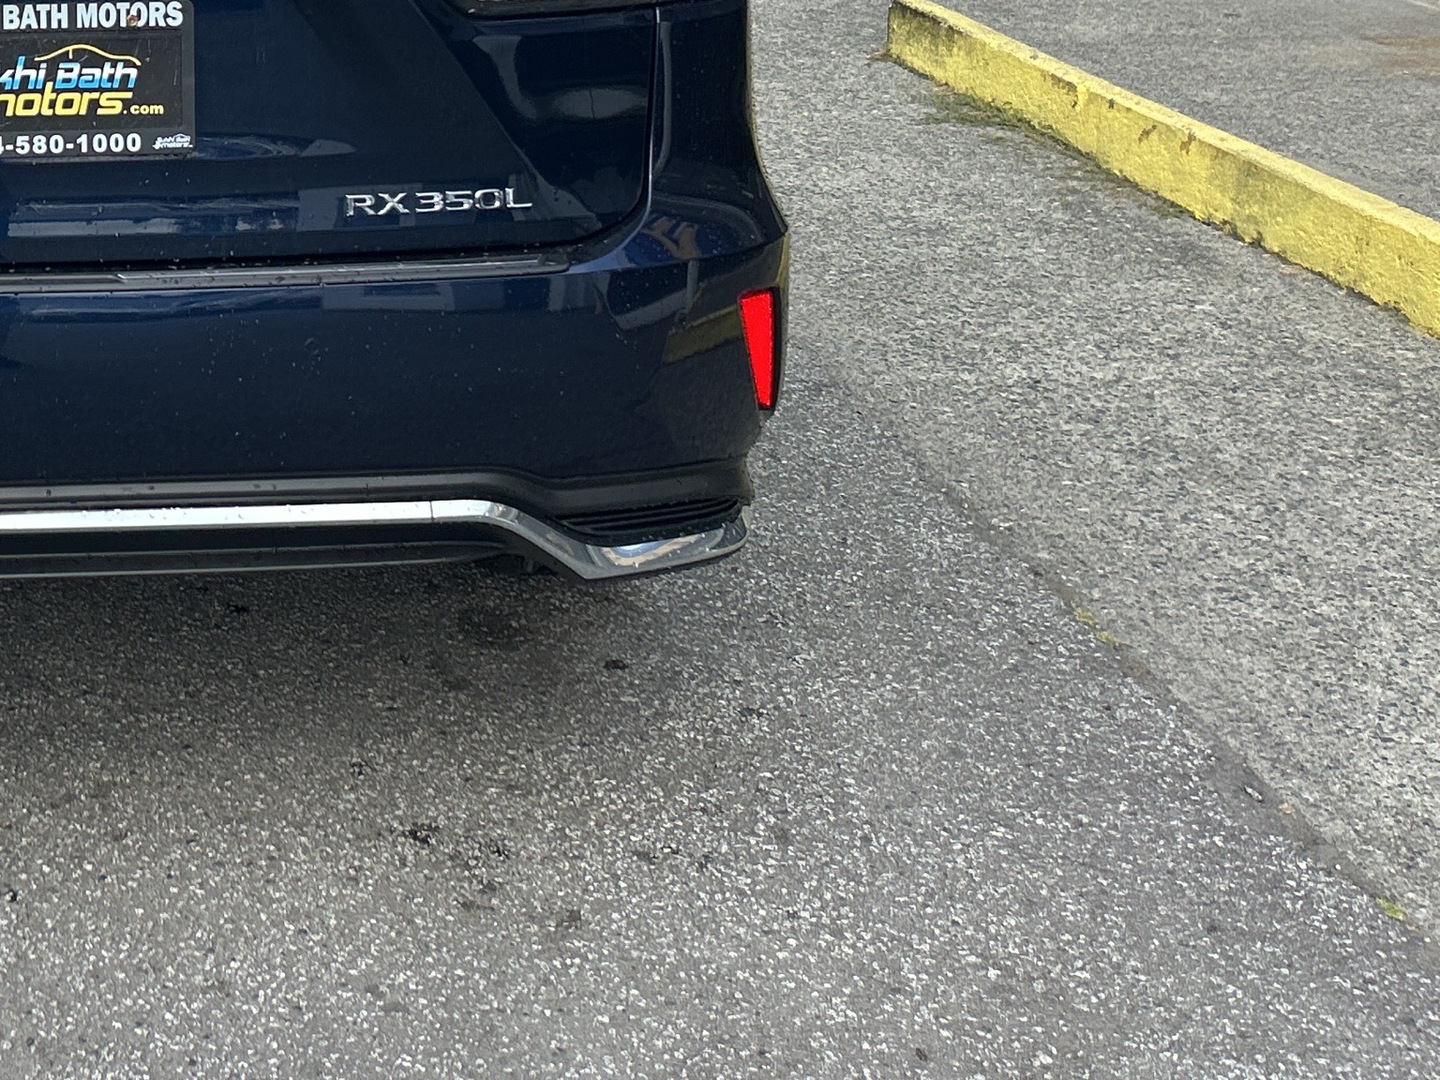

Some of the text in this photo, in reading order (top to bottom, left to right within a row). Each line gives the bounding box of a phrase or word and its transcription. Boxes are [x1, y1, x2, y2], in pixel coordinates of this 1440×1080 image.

[2, 3, 68, 30] BATH
[76, 1, 184, 29] MOTORS
[54, 61, 138, 90] Bath
[345, 187, 533, 217] RX 350L
